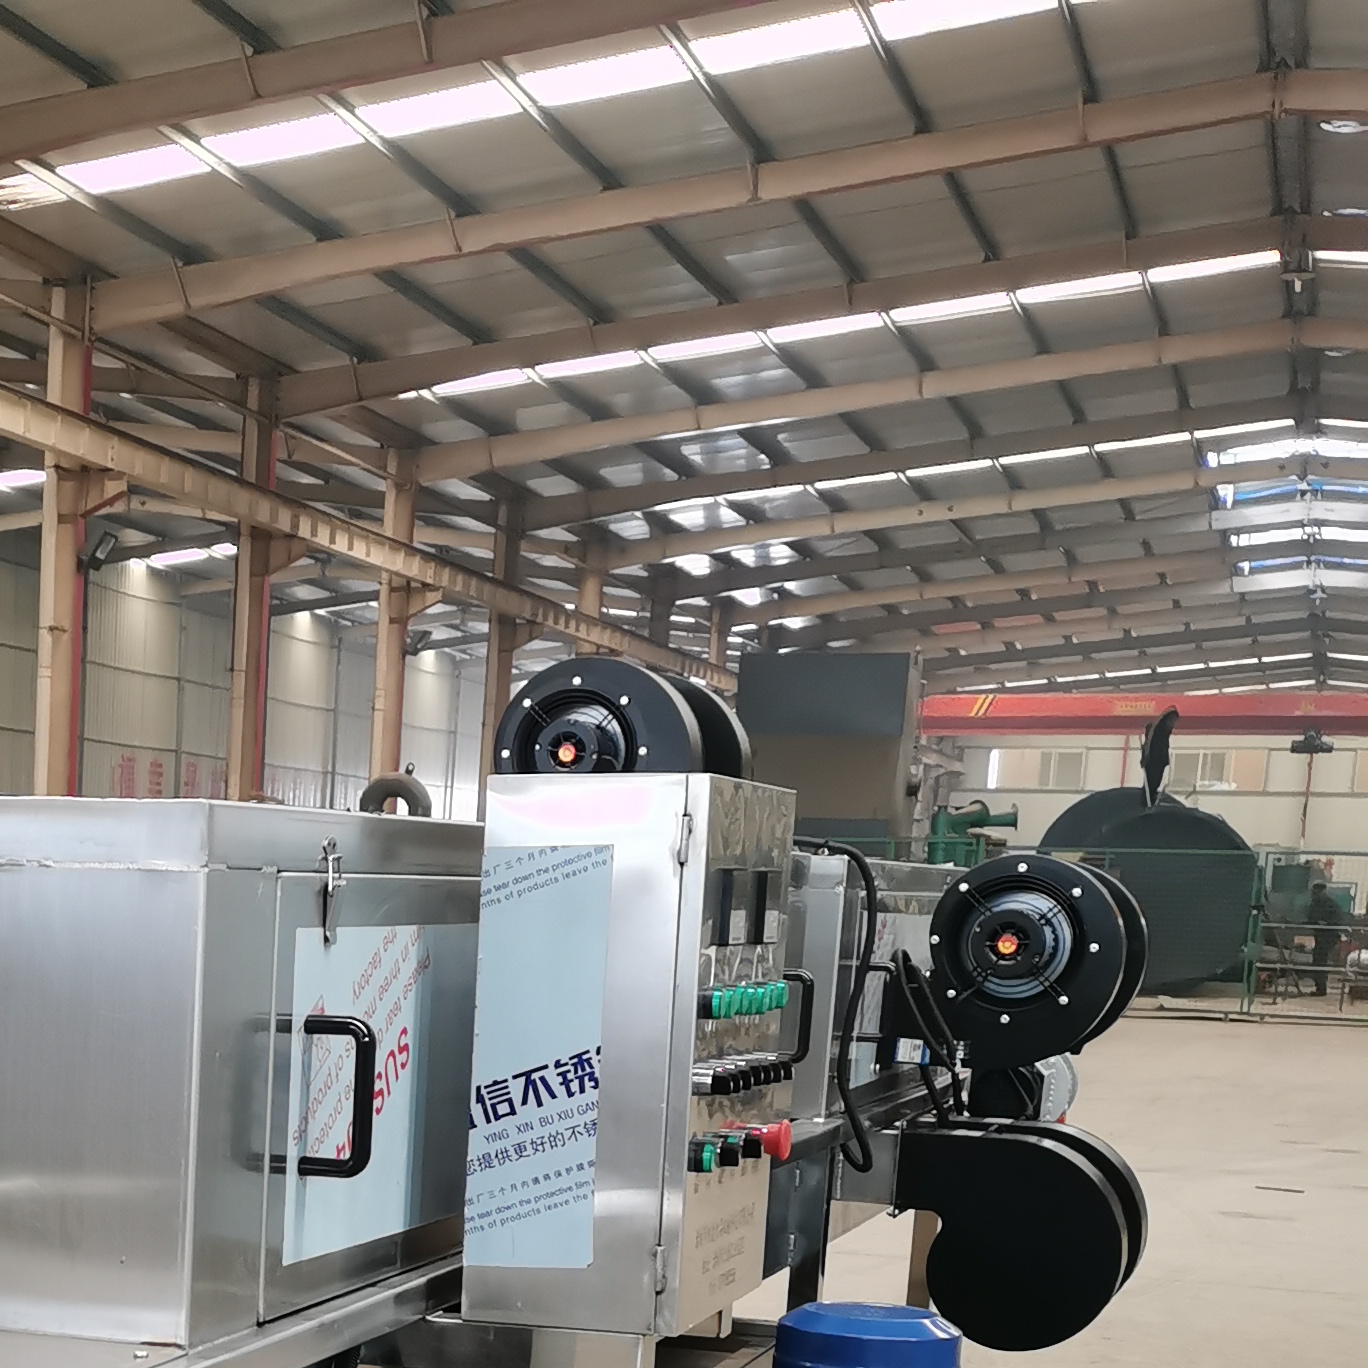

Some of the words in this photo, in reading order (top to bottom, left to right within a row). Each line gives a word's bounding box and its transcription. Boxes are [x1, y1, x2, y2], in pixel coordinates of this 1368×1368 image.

[516, 876, 559, 899] products
[561, 864, 589, 881] leave
[536, 866, 550, 877] the
[469, 1045, 601, 1129] 信不锈
[483, 1128, 510, 1145] YING
[515, 1121, 534, 1136] XIN
[539, 1114, 555, 1128] BU
[556, 1108, 575, 1123] XIU
[494, 1202, 518, 1216] down
[518, 1198, 532, 1208] the
[533, 1185, 574, 1205] protective
[499, 1207, 542, 1228] products
[543, 1198, 571, 1212] leave
